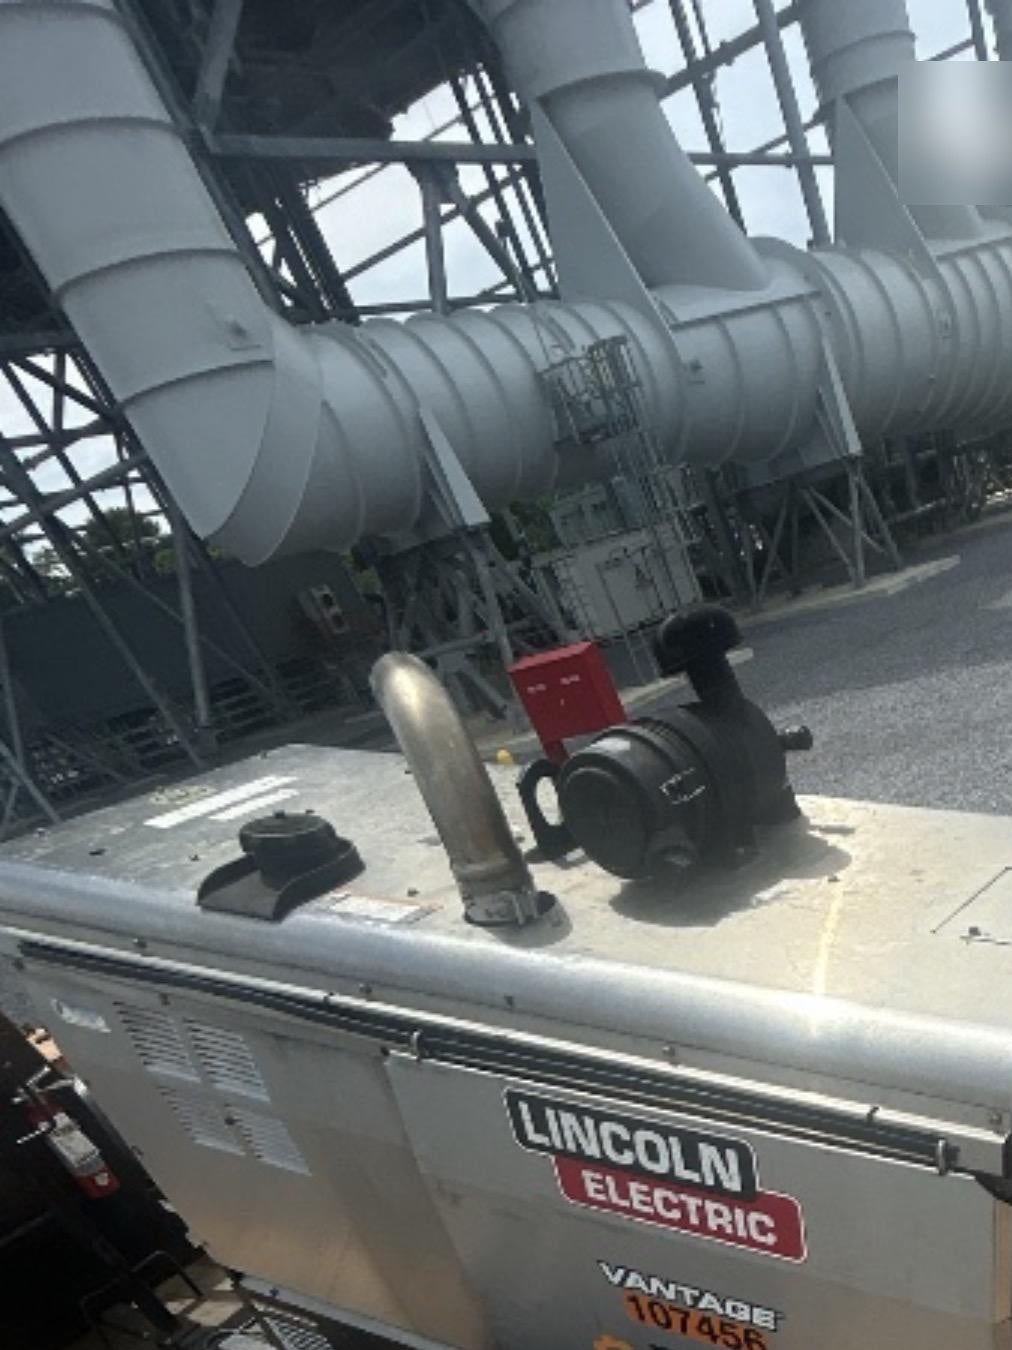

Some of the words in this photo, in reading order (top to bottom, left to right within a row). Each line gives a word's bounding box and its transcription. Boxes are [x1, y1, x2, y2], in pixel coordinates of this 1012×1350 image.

[518, 1101, 742, 1192] LINCOLN
[581, 1169, 778, 1246] ELECTRIC
[598, 1259, 778, 1332] VANTAGE
